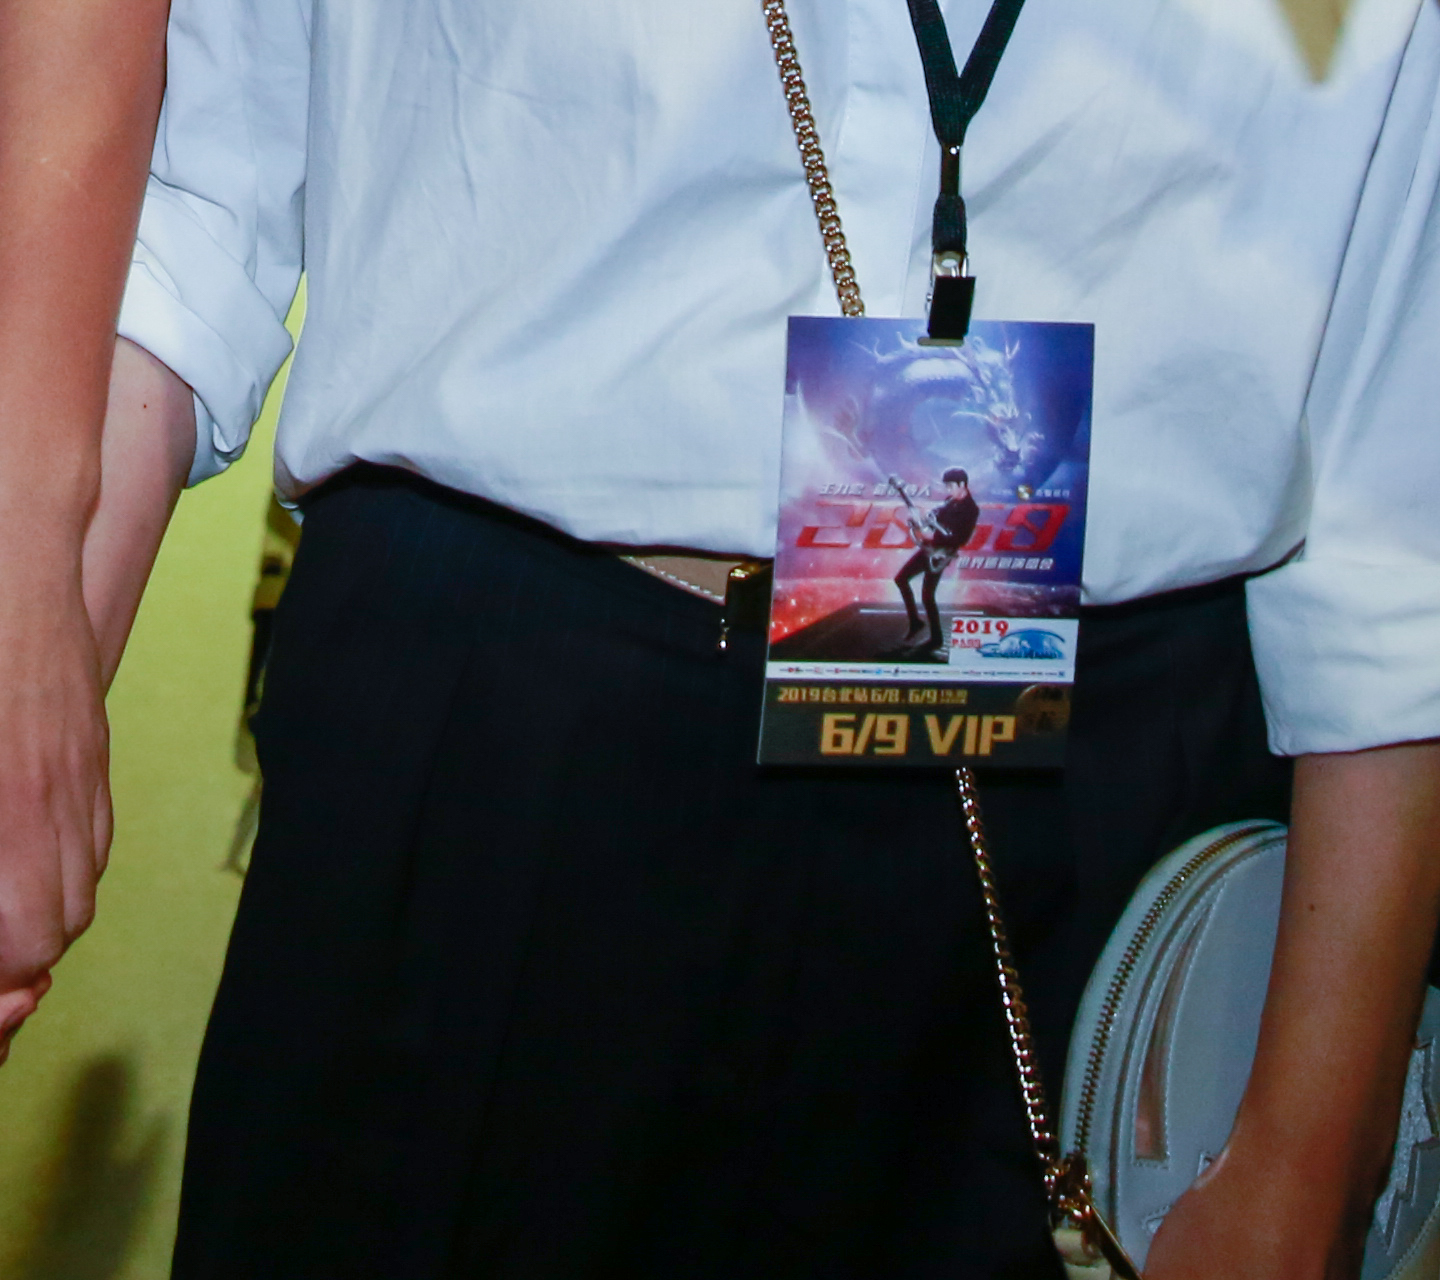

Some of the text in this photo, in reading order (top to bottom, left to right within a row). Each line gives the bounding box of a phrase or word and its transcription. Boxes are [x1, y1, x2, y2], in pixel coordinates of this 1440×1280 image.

[952, 620, 1009, 637] 2019
[821, 713, 1017, 756] 6/9 VIP
